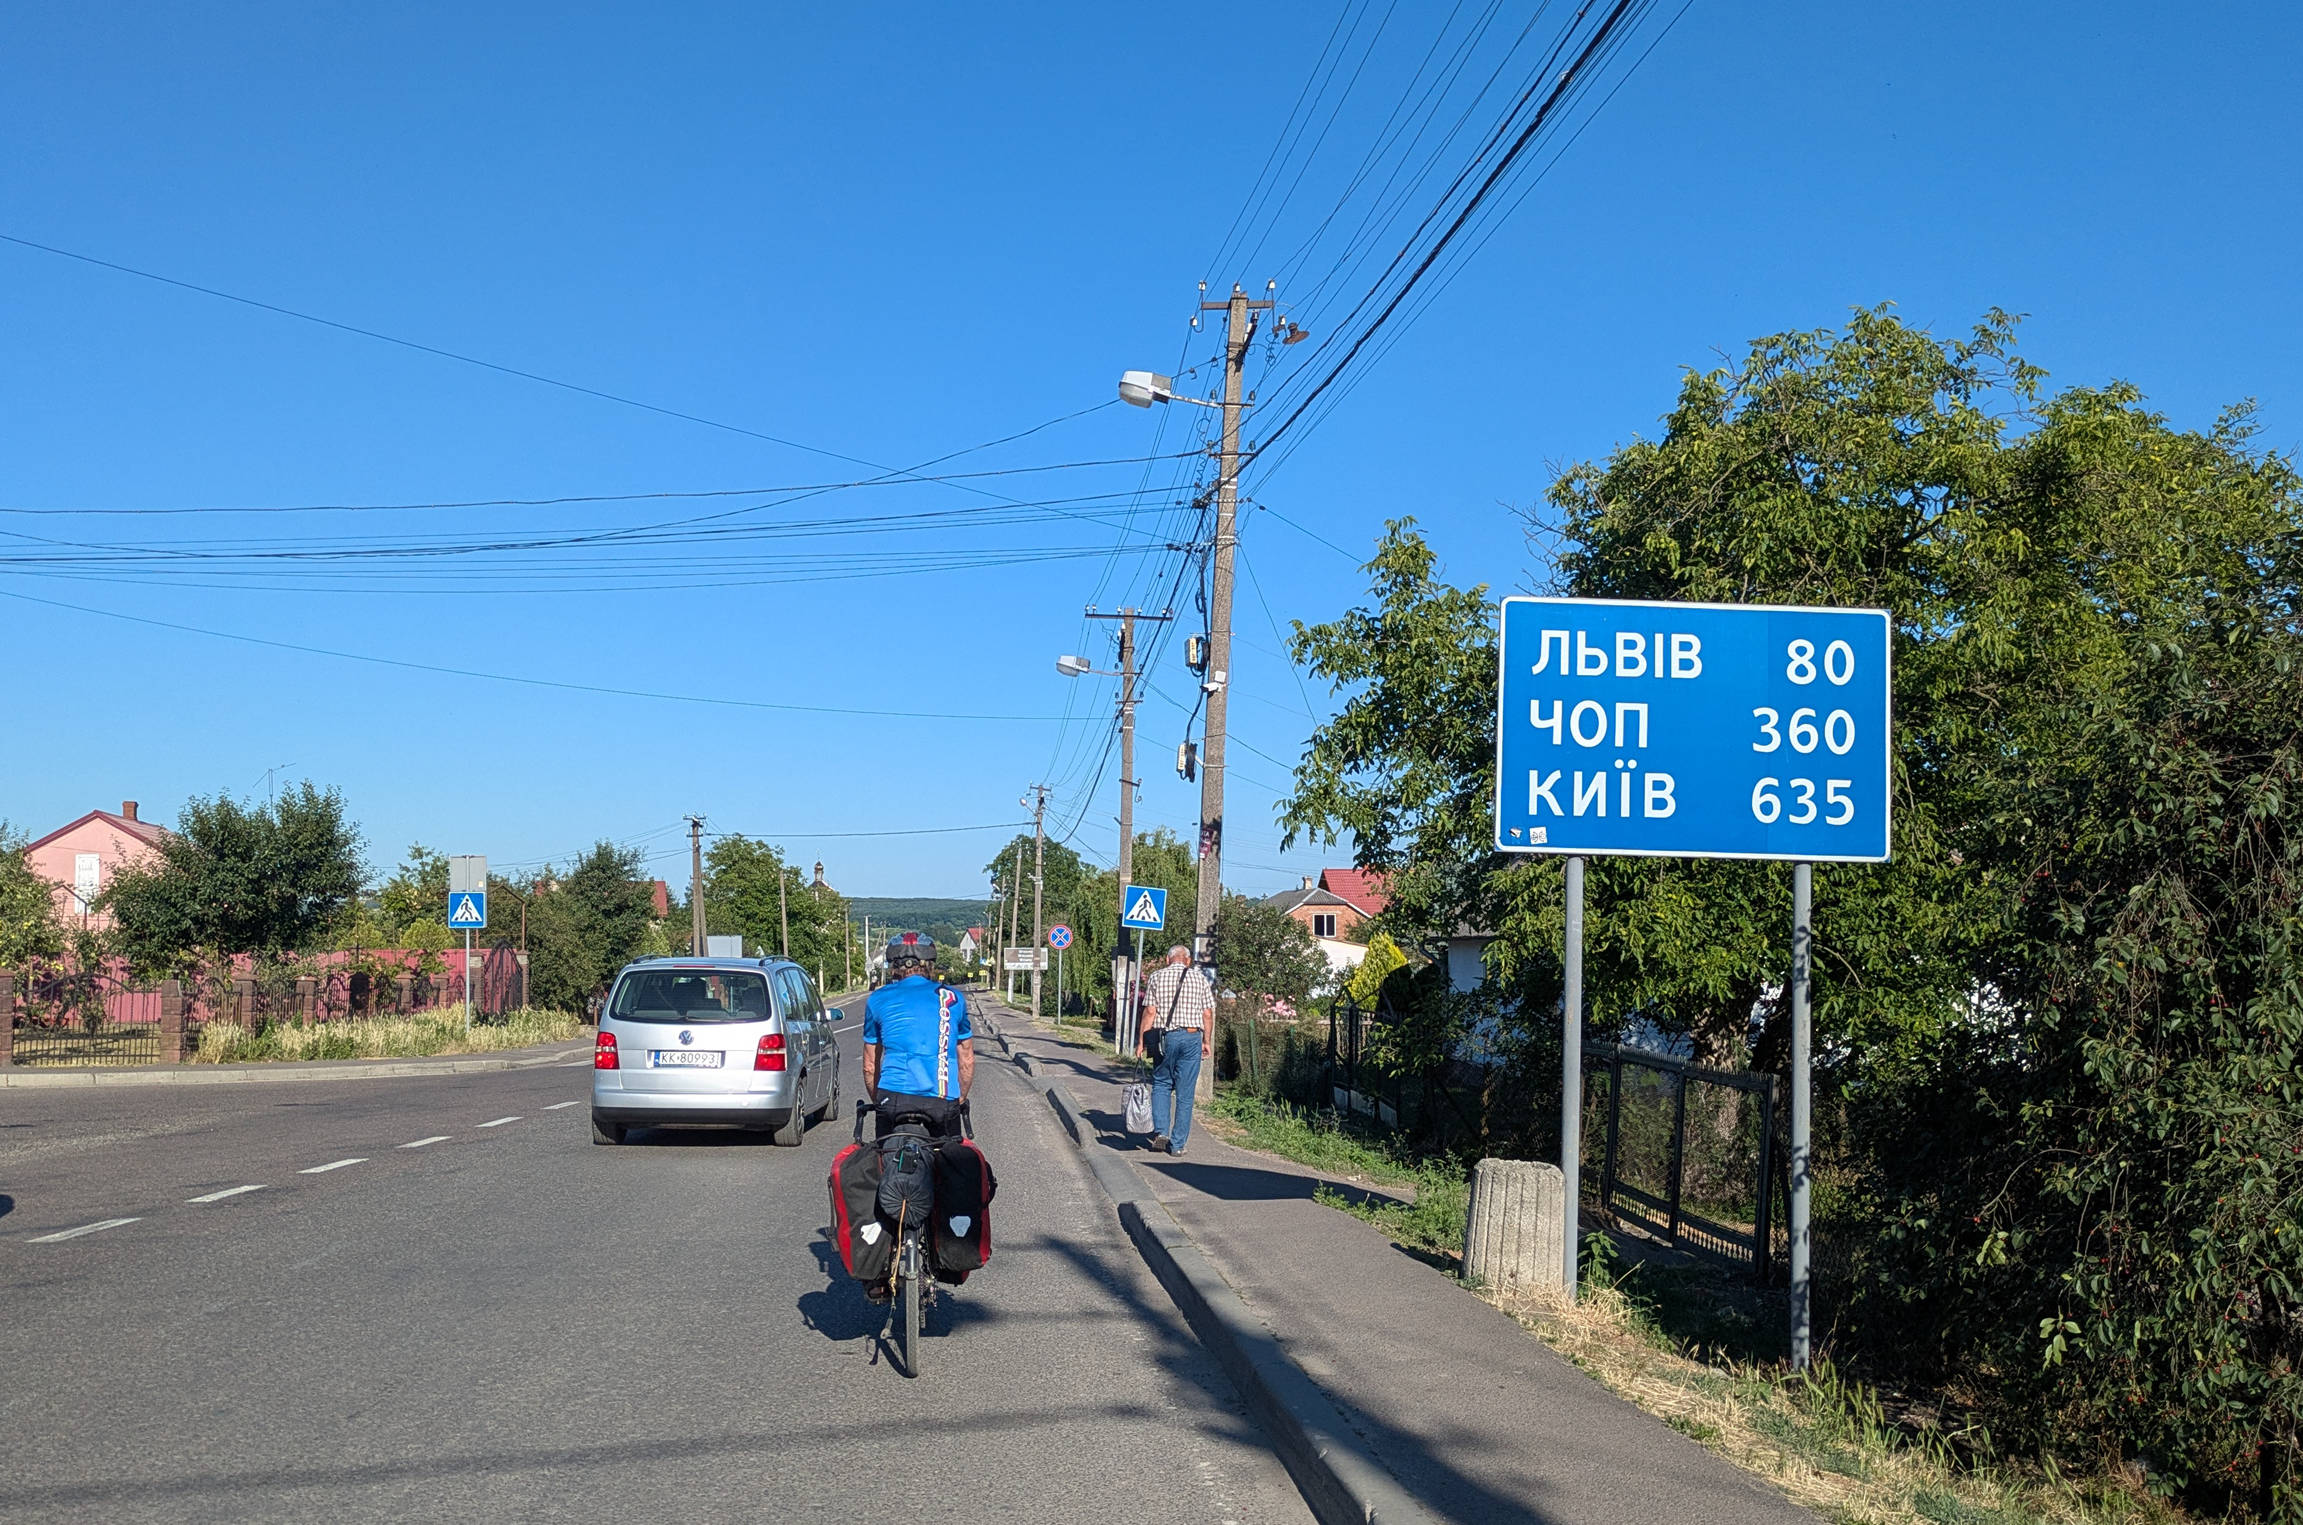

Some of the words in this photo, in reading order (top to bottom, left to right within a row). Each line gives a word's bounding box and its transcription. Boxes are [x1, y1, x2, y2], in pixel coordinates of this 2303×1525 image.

[1531, 629, 1703, 679] ЛЬВІВ
[1786, 638, 1856, 686] 80
[1529, 698, 1649, 749] ЧОП
[1752, 706, 1856, 755] 360
[1528, 759, 1676, 818] КИЇВ
[1751, 776, 1855, 826] 635
[937, 1007, 950, 1083] BASSO
